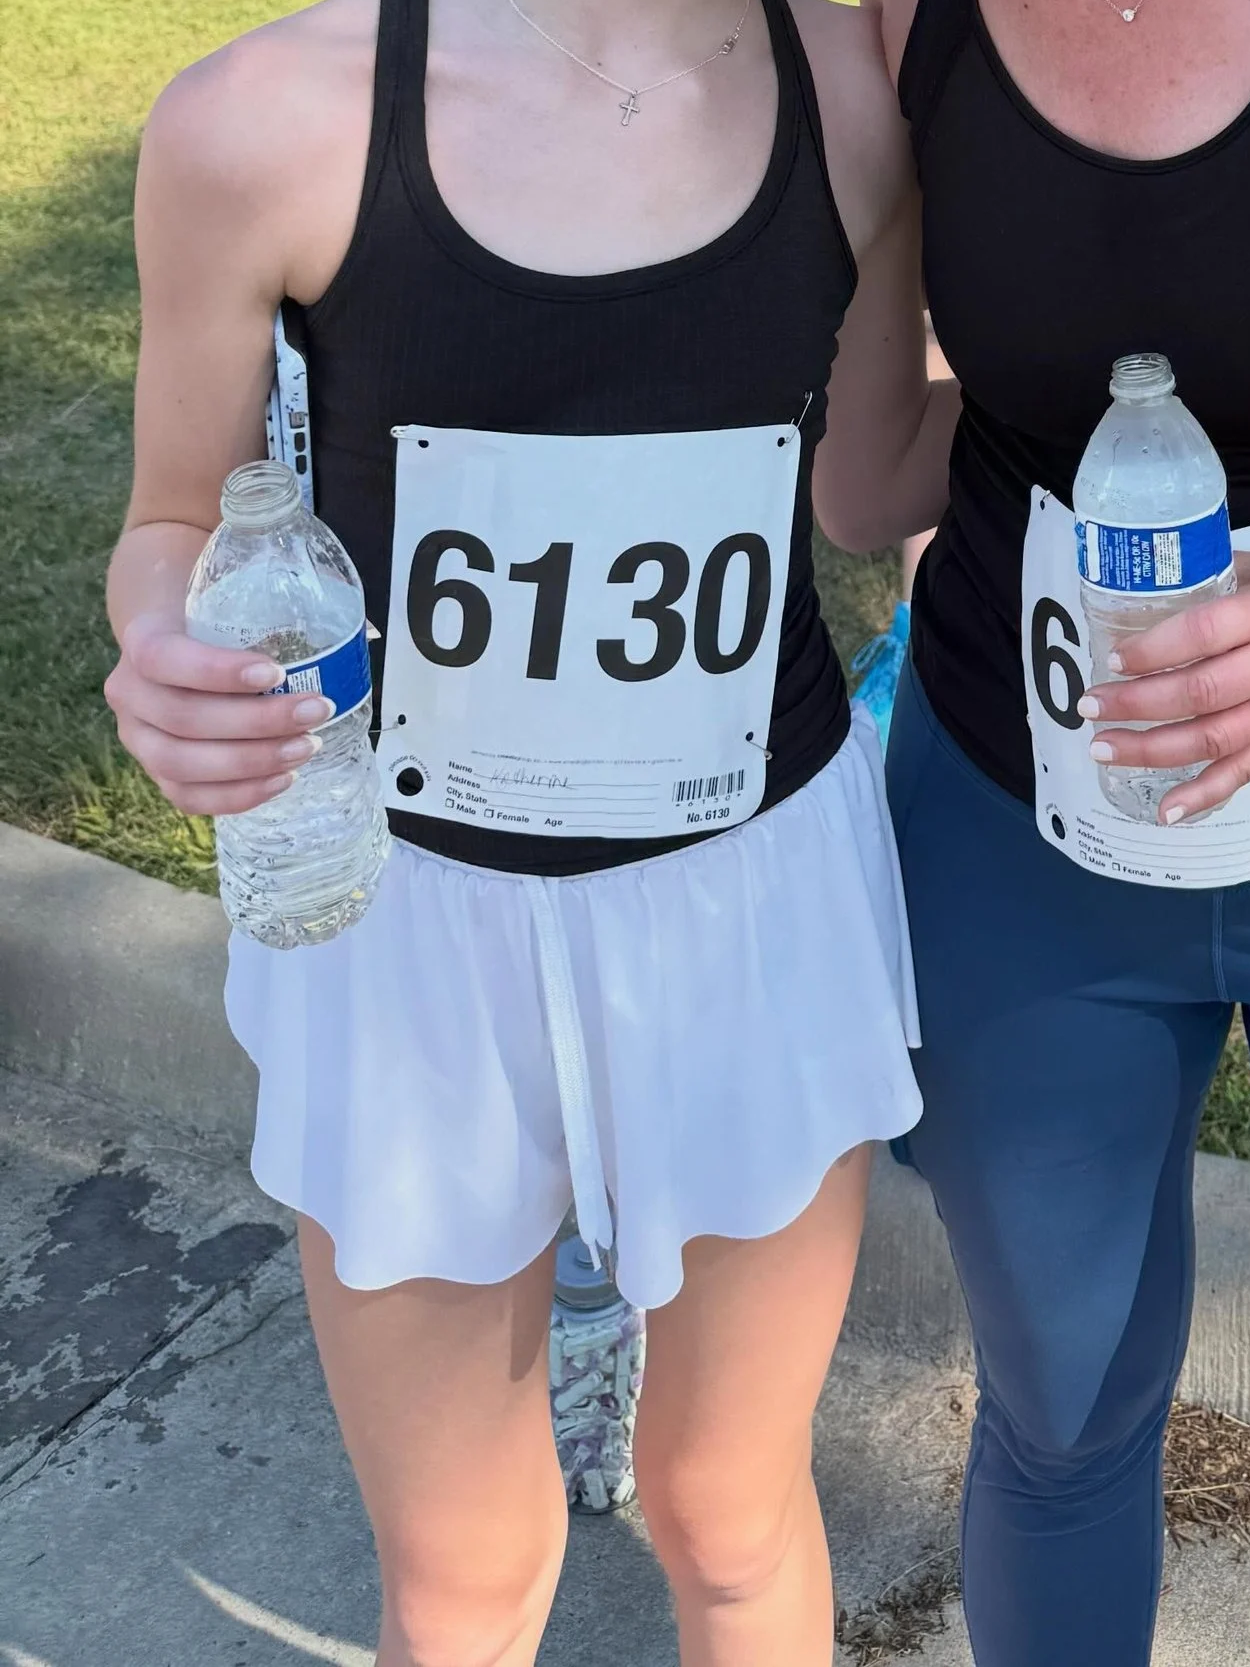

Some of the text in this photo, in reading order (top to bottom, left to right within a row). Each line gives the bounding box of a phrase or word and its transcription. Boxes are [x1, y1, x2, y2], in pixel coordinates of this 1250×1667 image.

[406, 529, 771, 682] 6130
[448, 761, 473, 774] Name
[447, 774, 481, 789] Address
[446, 787, 487, 804] City, State
[456, 803, 563, 827] Male Female Age
[686, 807, 730, 823] No. 6130
[1122, 866, 1152, 877] Female
[1164, 873, 1182, 881] Age
